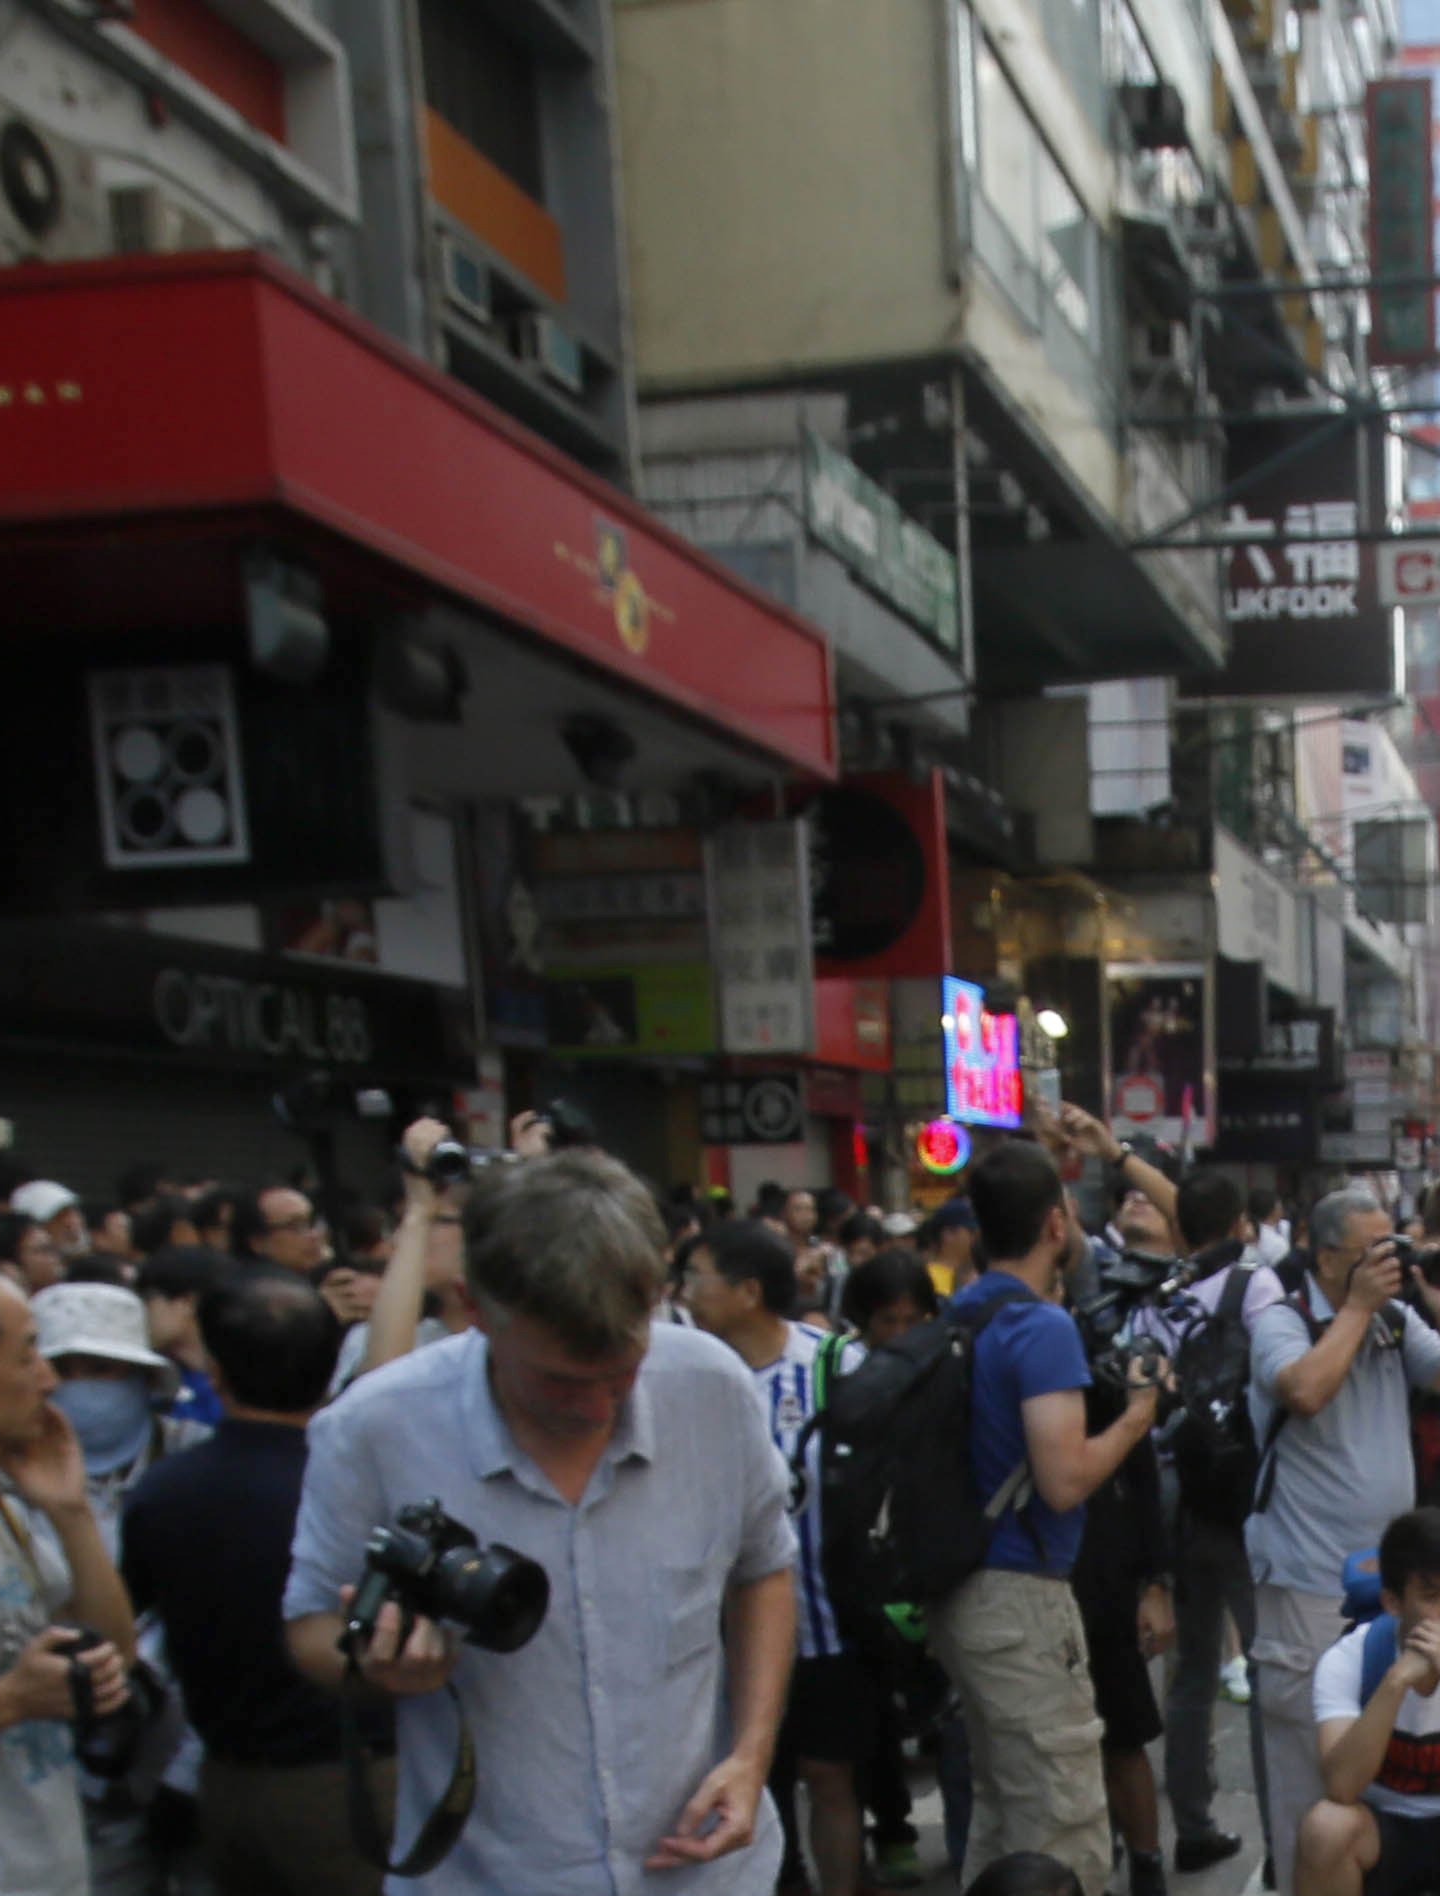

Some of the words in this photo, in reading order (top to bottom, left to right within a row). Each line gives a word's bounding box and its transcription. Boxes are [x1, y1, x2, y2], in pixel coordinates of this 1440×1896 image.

[1220, 502, 1360, 584] 六福
[1224, 584, 1358, 621] UKFOOK
[153, 968, 329, 1061] OPTICAL
